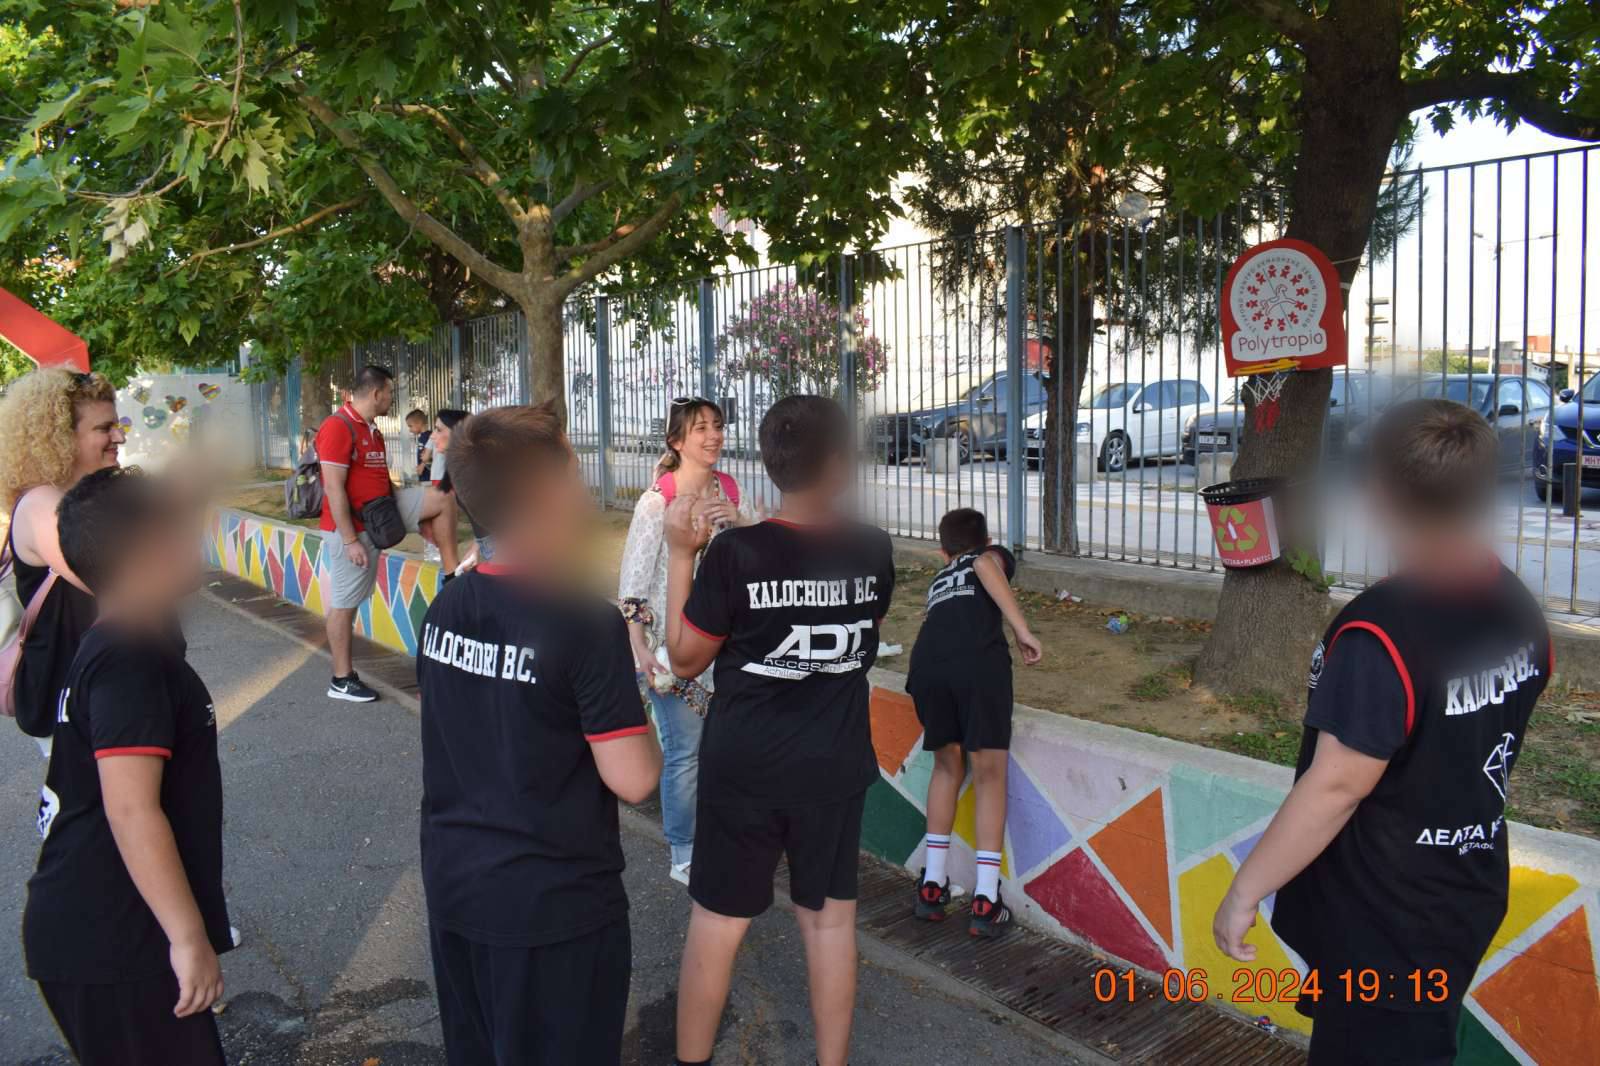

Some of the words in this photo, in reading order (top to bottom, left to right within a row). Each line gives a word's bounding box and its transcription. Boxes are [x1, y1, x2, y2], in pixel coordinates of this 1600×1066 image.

[1238, 329, 1324, 355] Polytropio
[746, 580, 848, 609] KALOCHORI
[764, 619, 873, 661] ADT
[1416, 823, 1485, 846] ΔΕΛΤΑ
